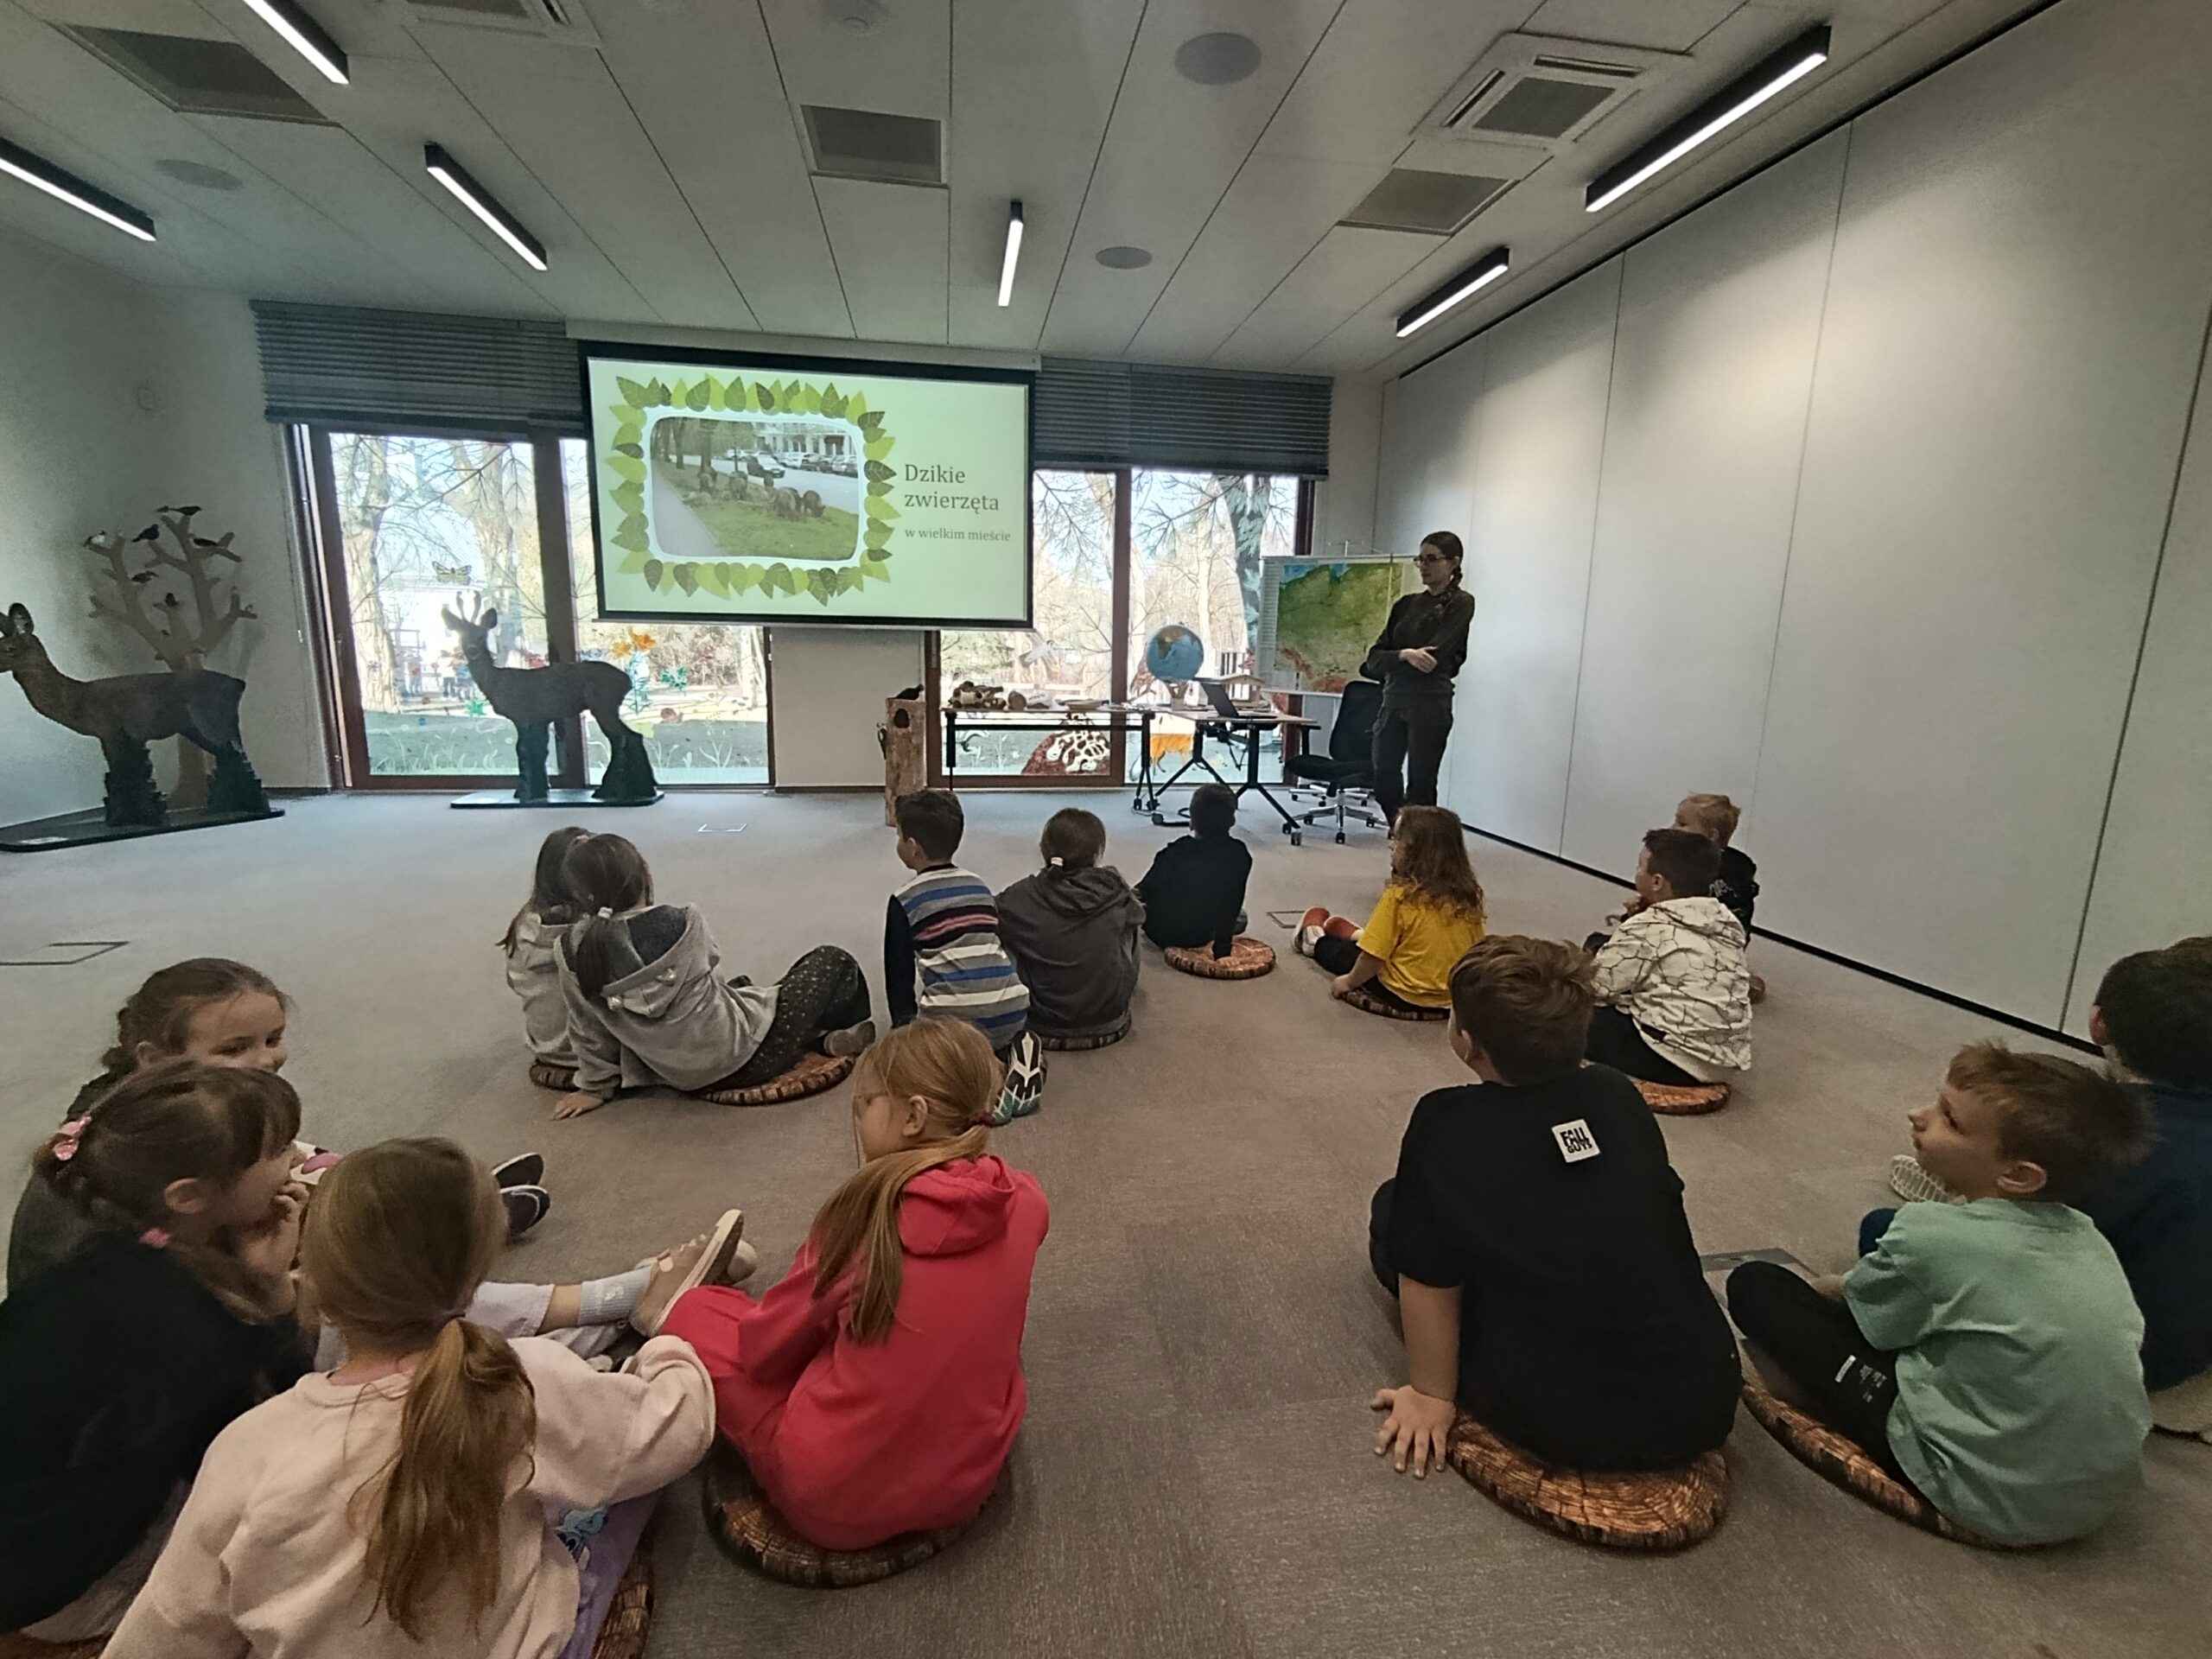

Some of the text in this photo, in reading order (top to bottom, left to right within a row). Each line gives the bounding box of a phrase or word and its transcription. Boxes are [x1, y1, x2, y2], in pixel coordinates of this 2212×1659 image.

[905, 464, 965, 484] Dzikie
[905, 491, 999, 514] zwierzęta
[905, 527, 1011, 542] w wielkim mieście
[1560, 1127, 1590, 1147] FALL
